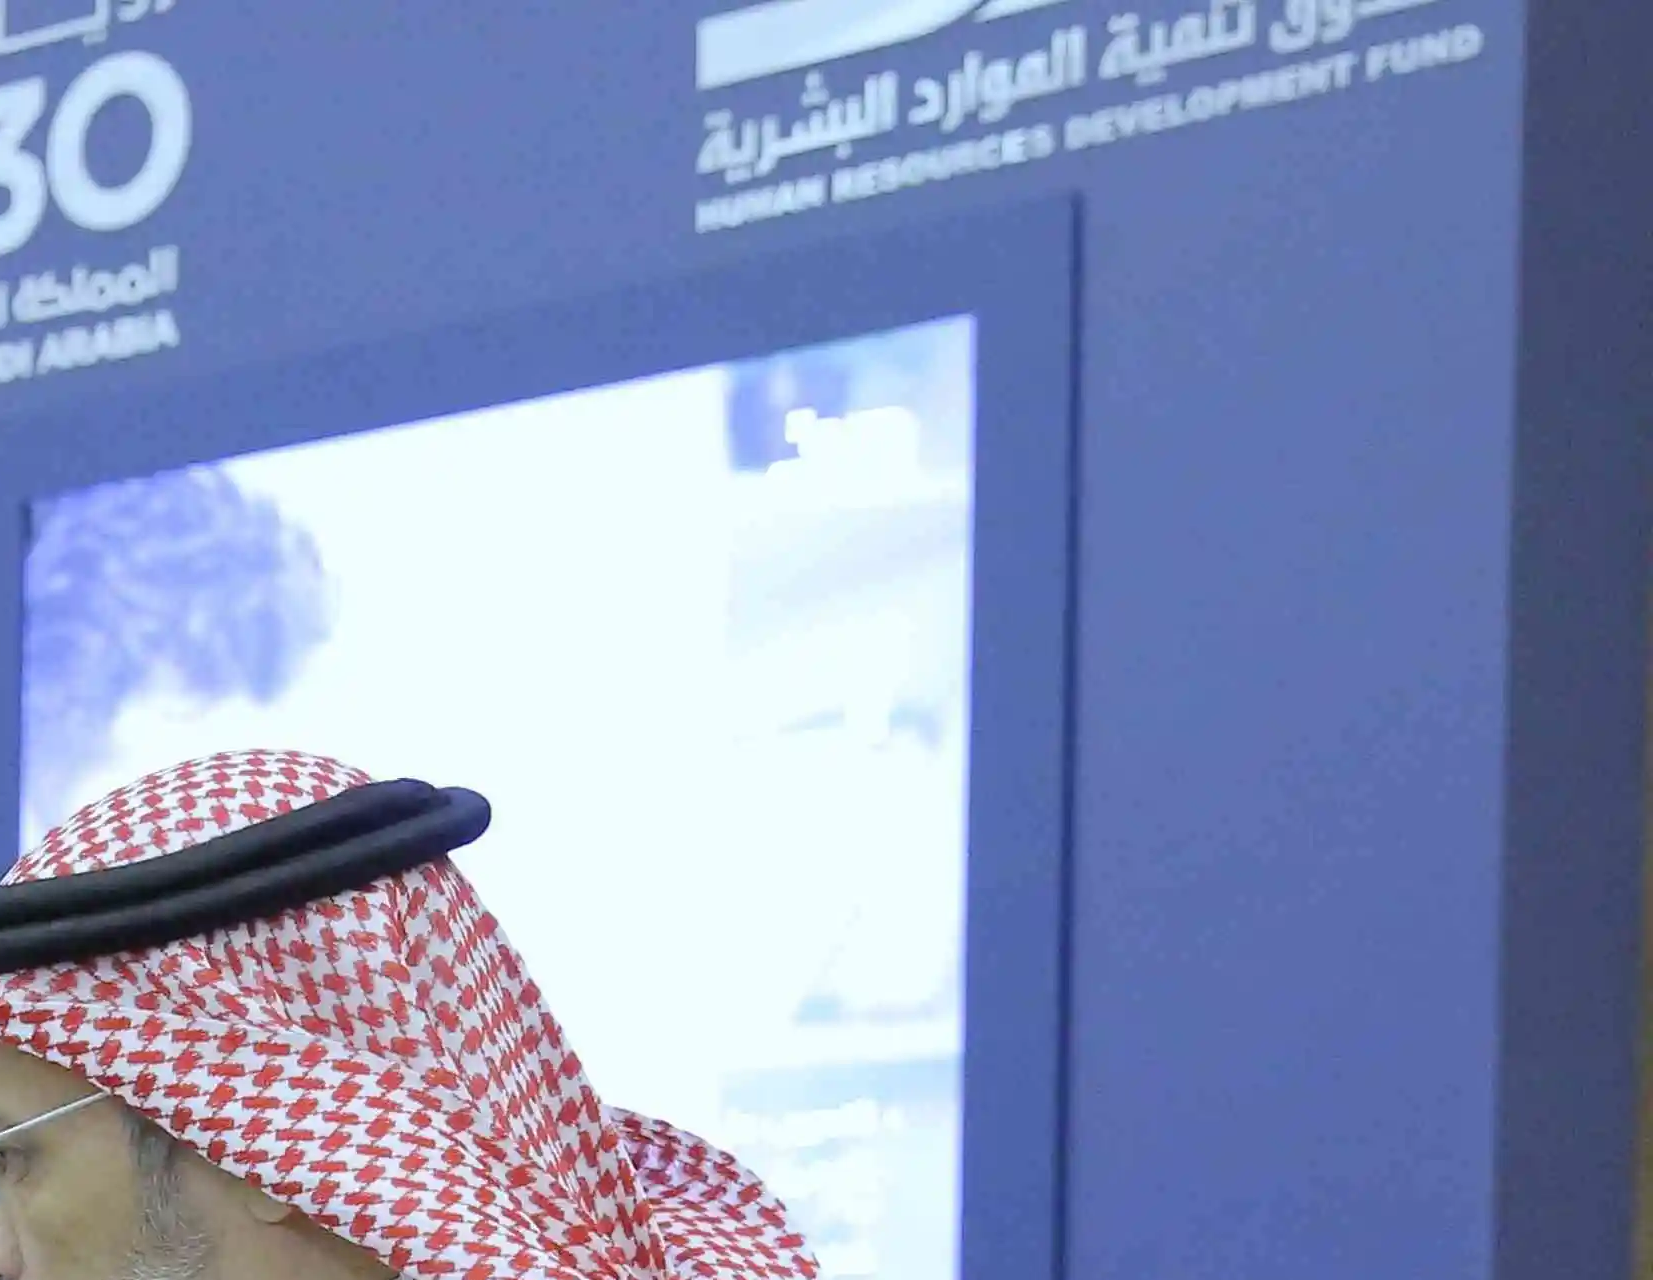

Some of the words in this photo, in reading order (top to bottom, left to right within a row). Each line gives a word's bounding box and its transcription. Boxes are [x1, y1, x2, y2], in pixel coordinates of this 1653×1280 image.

[695, 174, 825, 234] HUMAN
[832, 124, 1056, 203] RESOURCES
[1065, 52, 1359, 151] DEVELOPMENT
[1365, 23, 1484, 83] FUND
[697, 69, 899, 184] البشرية
[908, 25, 1086, 133] الموارد
[36, 308, 180, 374] ARABIA
